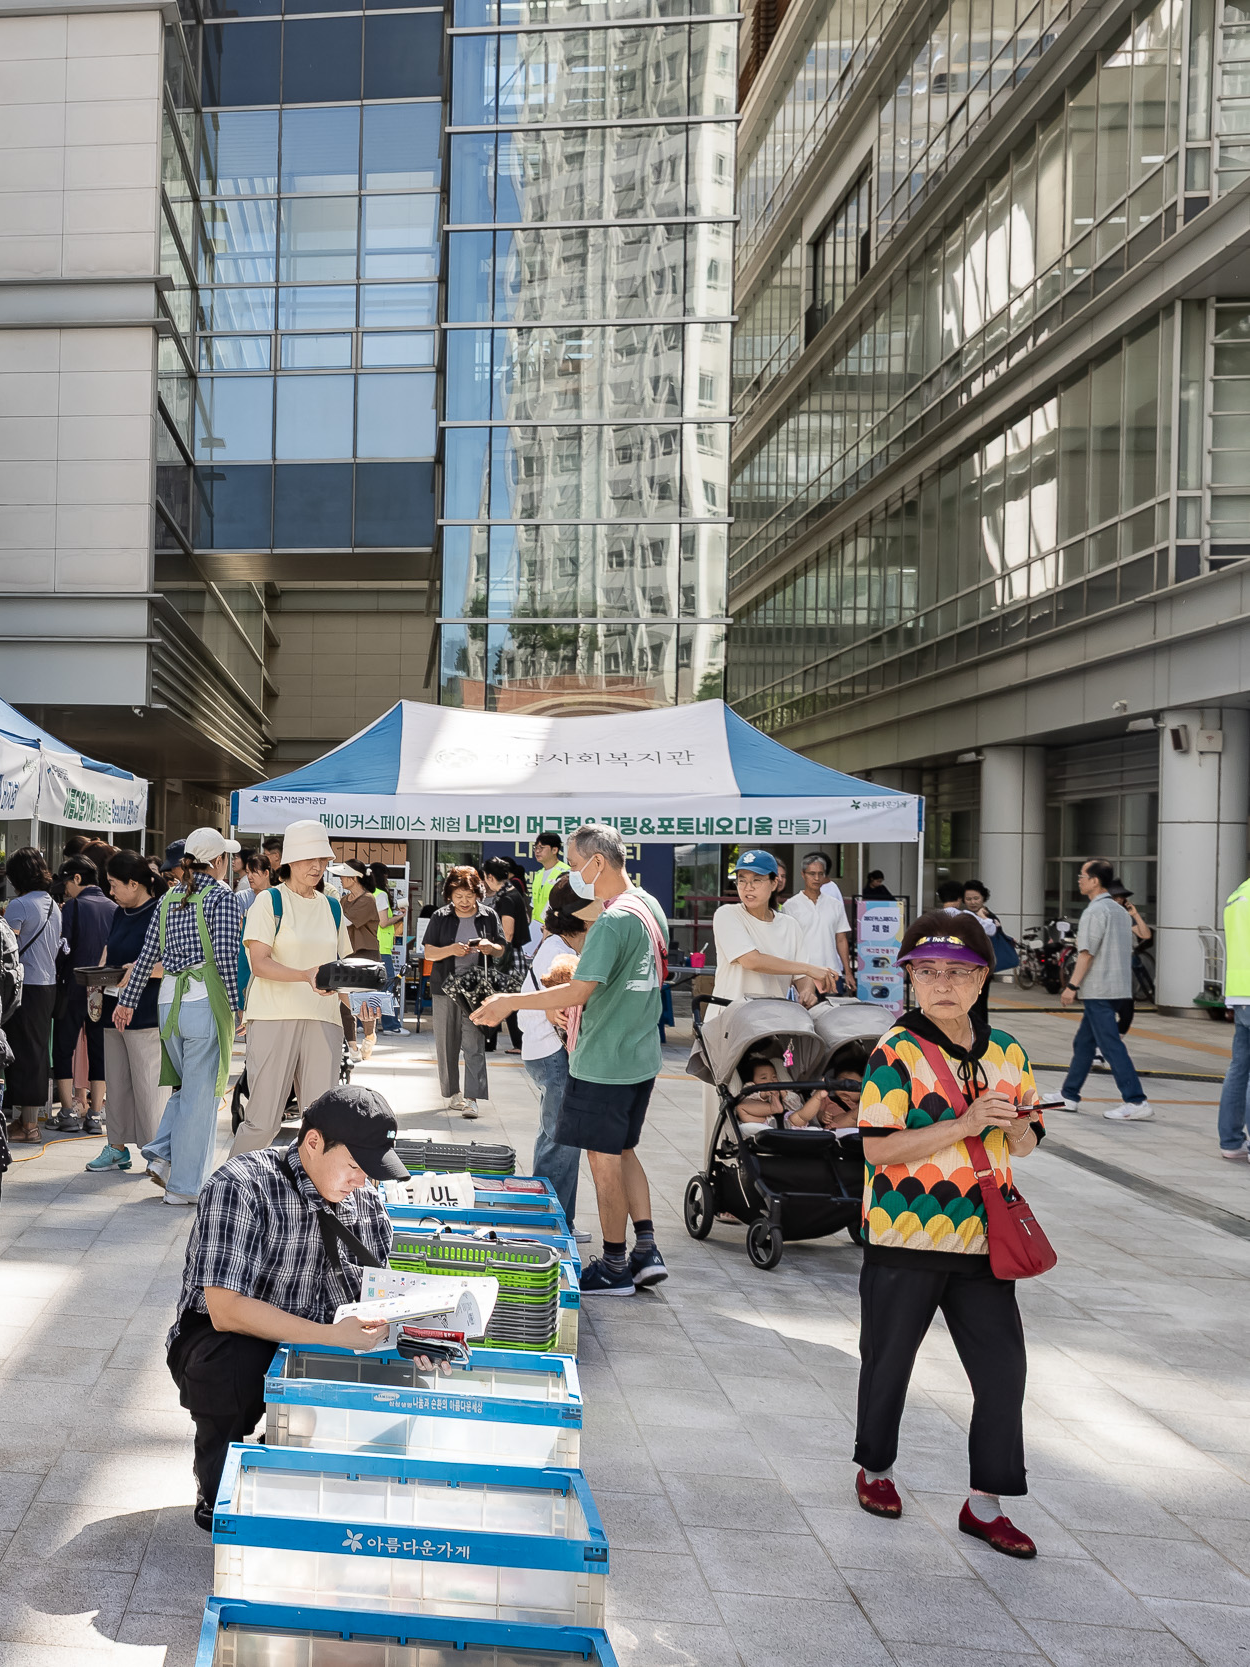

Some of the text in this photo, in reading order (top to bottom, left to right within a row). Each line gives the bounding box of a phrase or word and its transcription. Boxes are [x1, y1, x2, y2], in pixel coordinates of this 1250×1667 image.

[262, 795, 327, 805] 광진구시설관리공단
[320, 813, 426, 832] 메이커스페이스
[430, 816, 461, 833] 체험
[465, 815, 521, 834] 나만의
[778, 818, 828, 836] 만들기
[431, 1397, 448, 1411] 순환의
[367, 1536, 470, 1560] 아름다운가게
